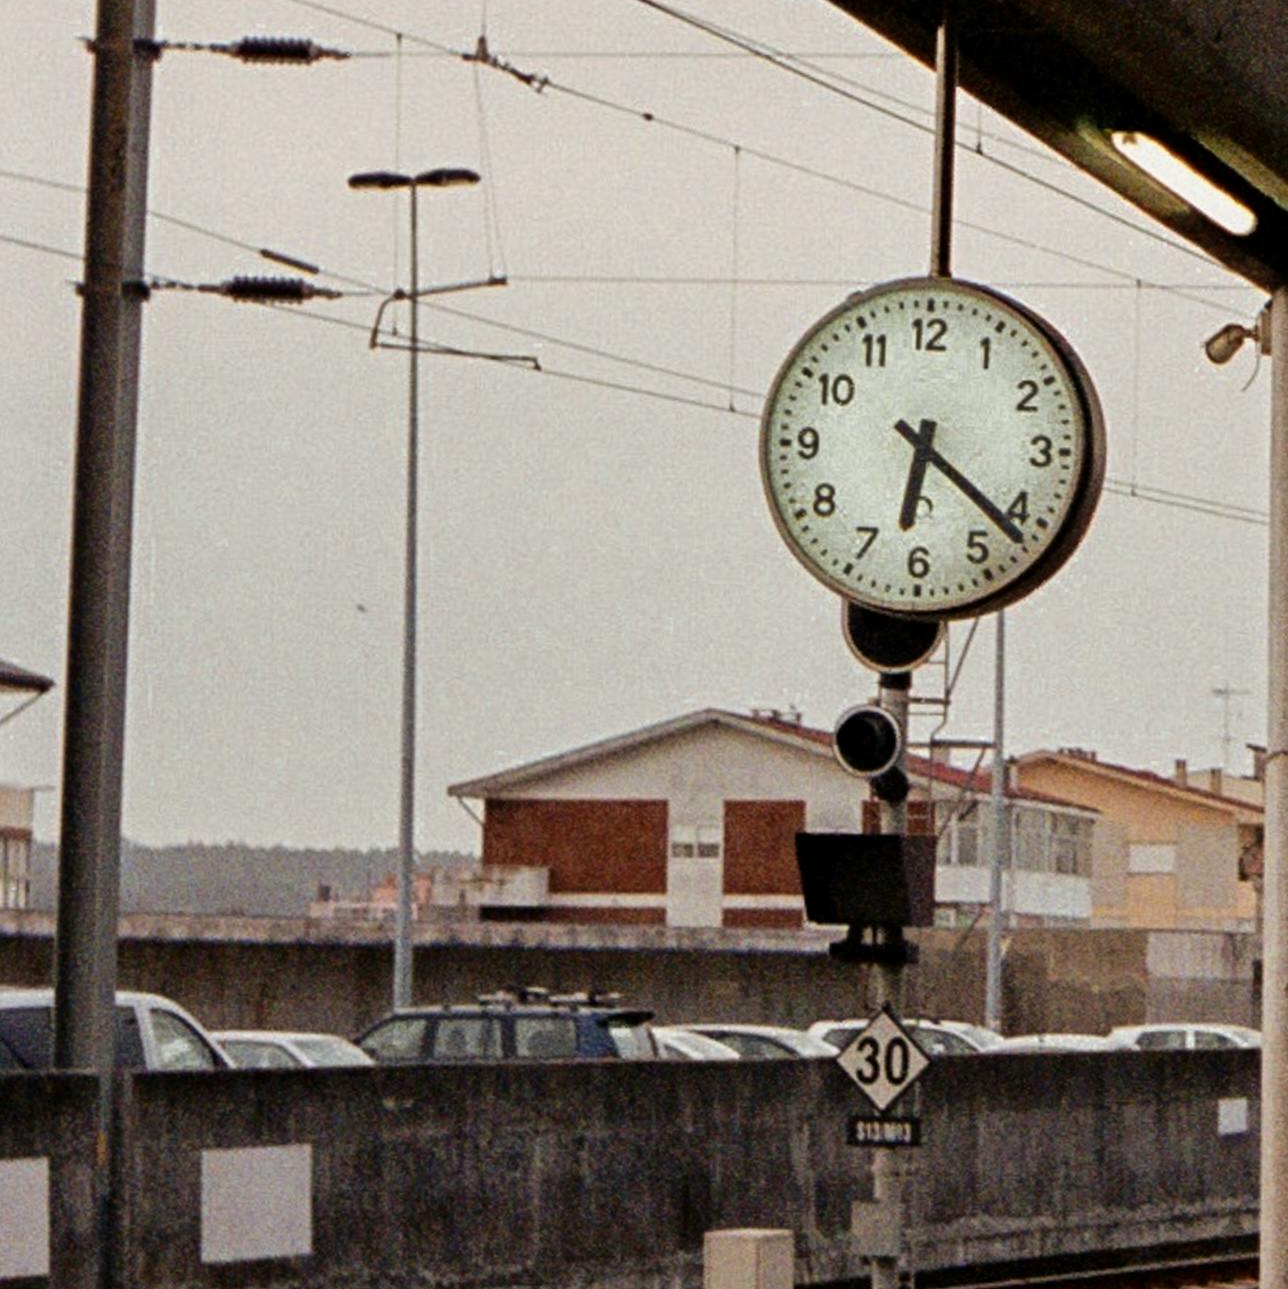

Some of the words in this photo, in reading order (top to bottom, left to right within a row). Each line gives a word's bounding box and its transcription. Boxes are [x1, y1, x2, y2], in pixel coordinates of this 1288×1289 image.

[863, 334, 886, 367] 11
[912, 318, 947, 351] 12
[980, 337, 990, 369] 1
[819, 374, 854, 406] 10
[1016, 380, 1038, 412] 2
[798, 427, 819, 460] 9
[1030, 436, 1053, 468] 3
[813, 483, 835, 517] 8
[1008, 489, 1029, 525] 4
[856, 527, 879, 559] 7
[966, 531, 989, 565] 5
[908, 547, 930, 579] 6
[856, 1037, 909, 1085] 30
